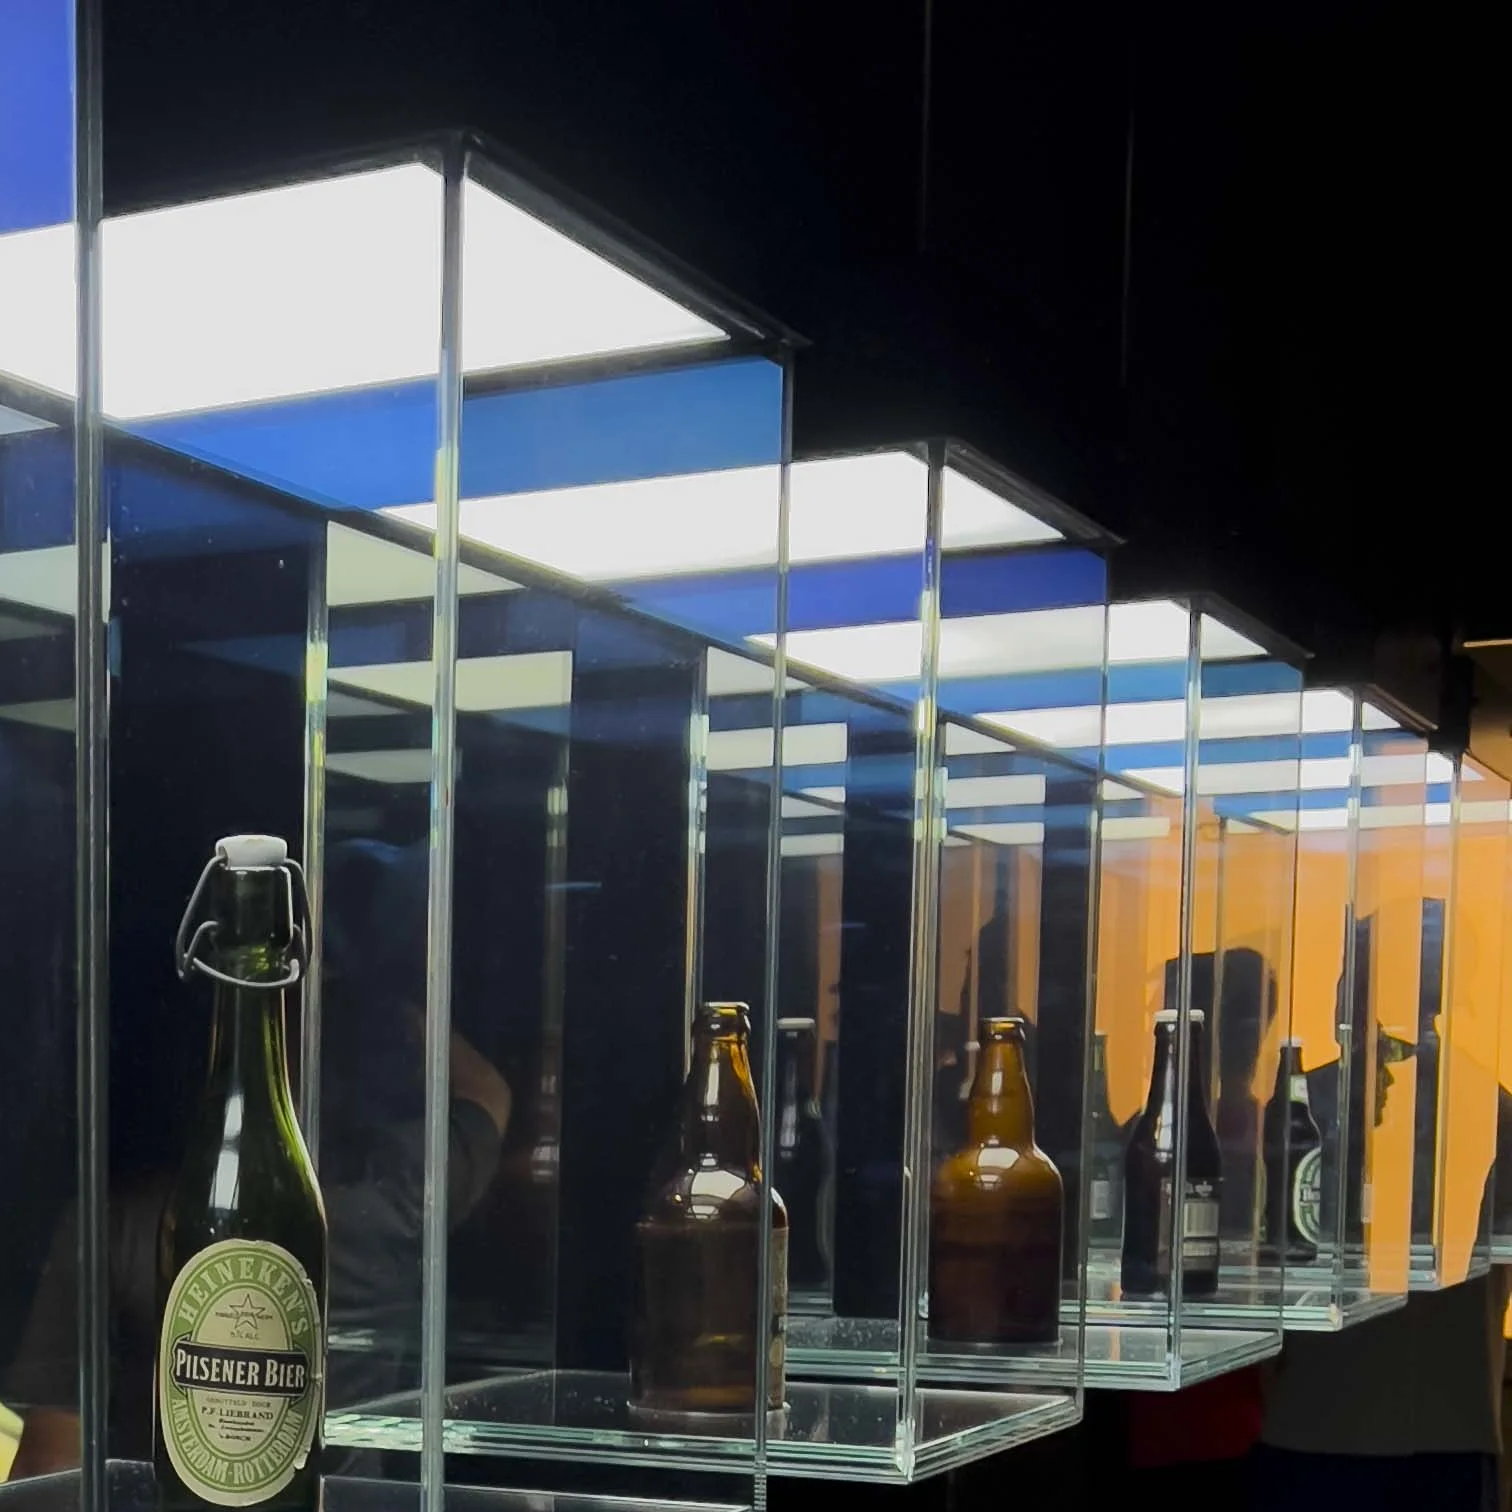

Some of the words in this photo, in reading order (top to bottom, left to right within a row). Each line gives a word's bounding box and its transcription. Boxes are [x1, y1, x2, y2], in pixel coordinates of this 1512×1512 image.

[178, 1256, 308, 1336] HEINEKEN'S
[175, 1348, 260, 1387] PILSENER
[264, 1358, 305, 1389] BIER
